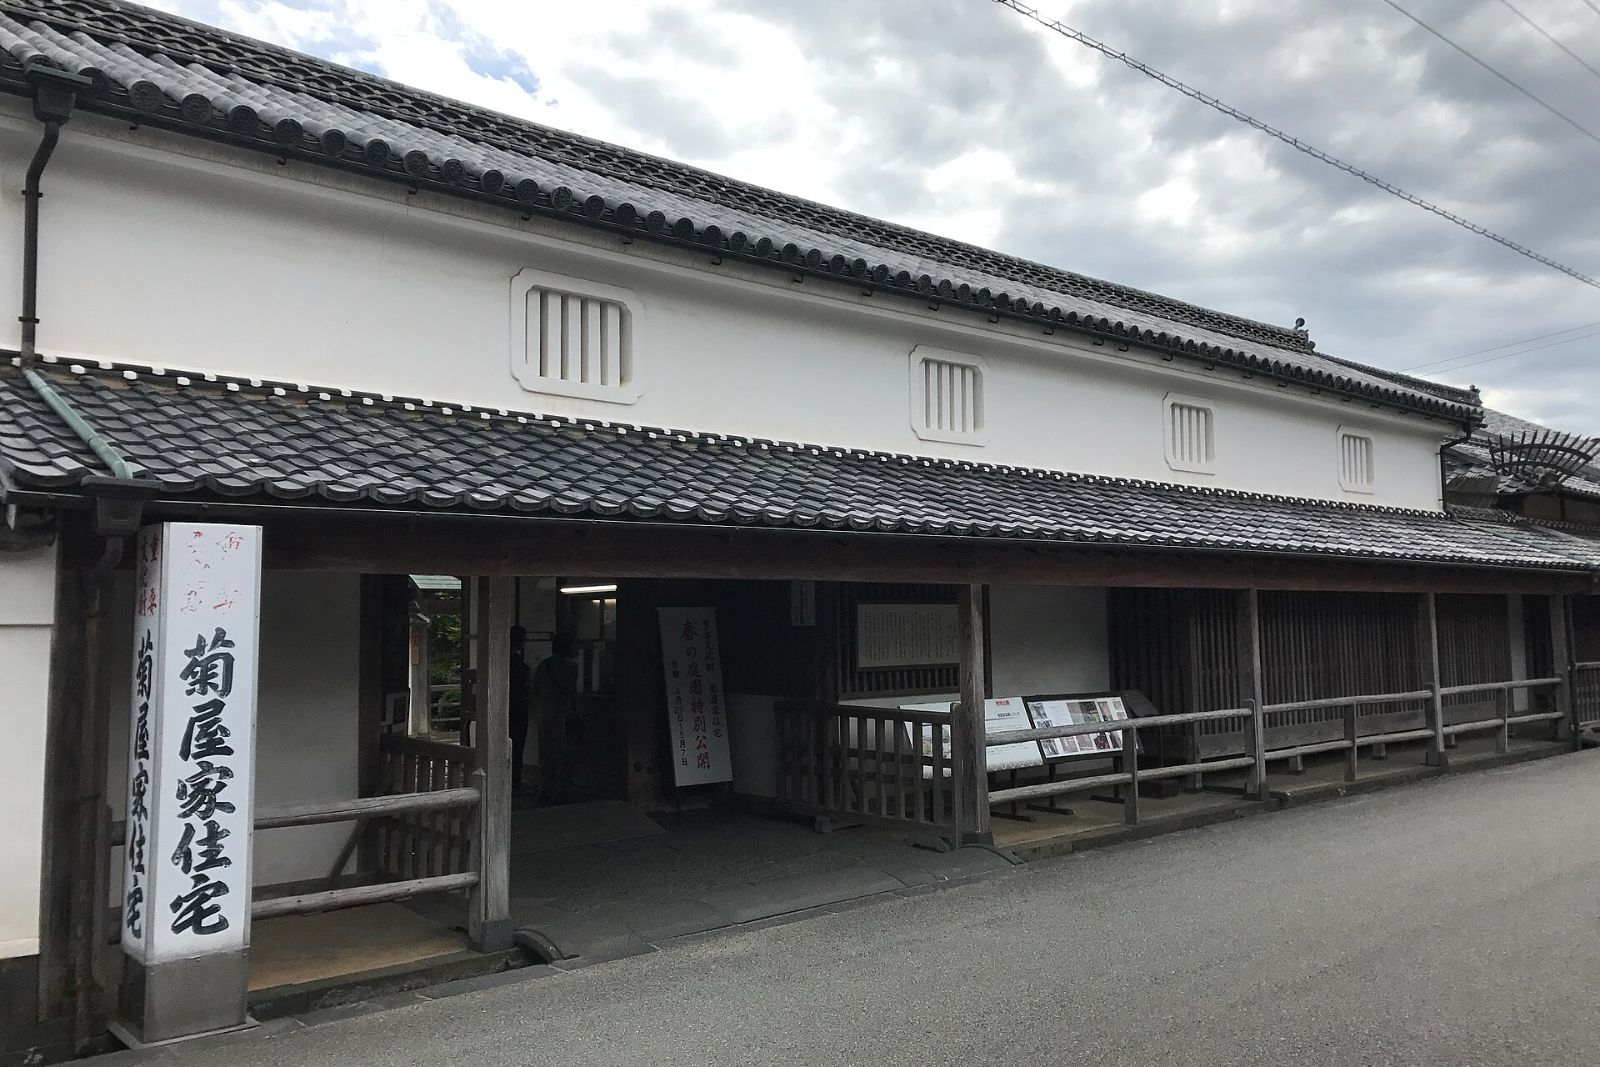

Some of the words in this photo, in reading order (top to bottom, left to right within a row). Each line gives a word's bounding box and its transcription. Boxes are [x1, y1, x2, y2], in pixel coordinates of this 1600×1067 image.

[126, 629, 153, 940] 菊屋家住宅
[168, 626, 237, 937] 菊屋家住宅
